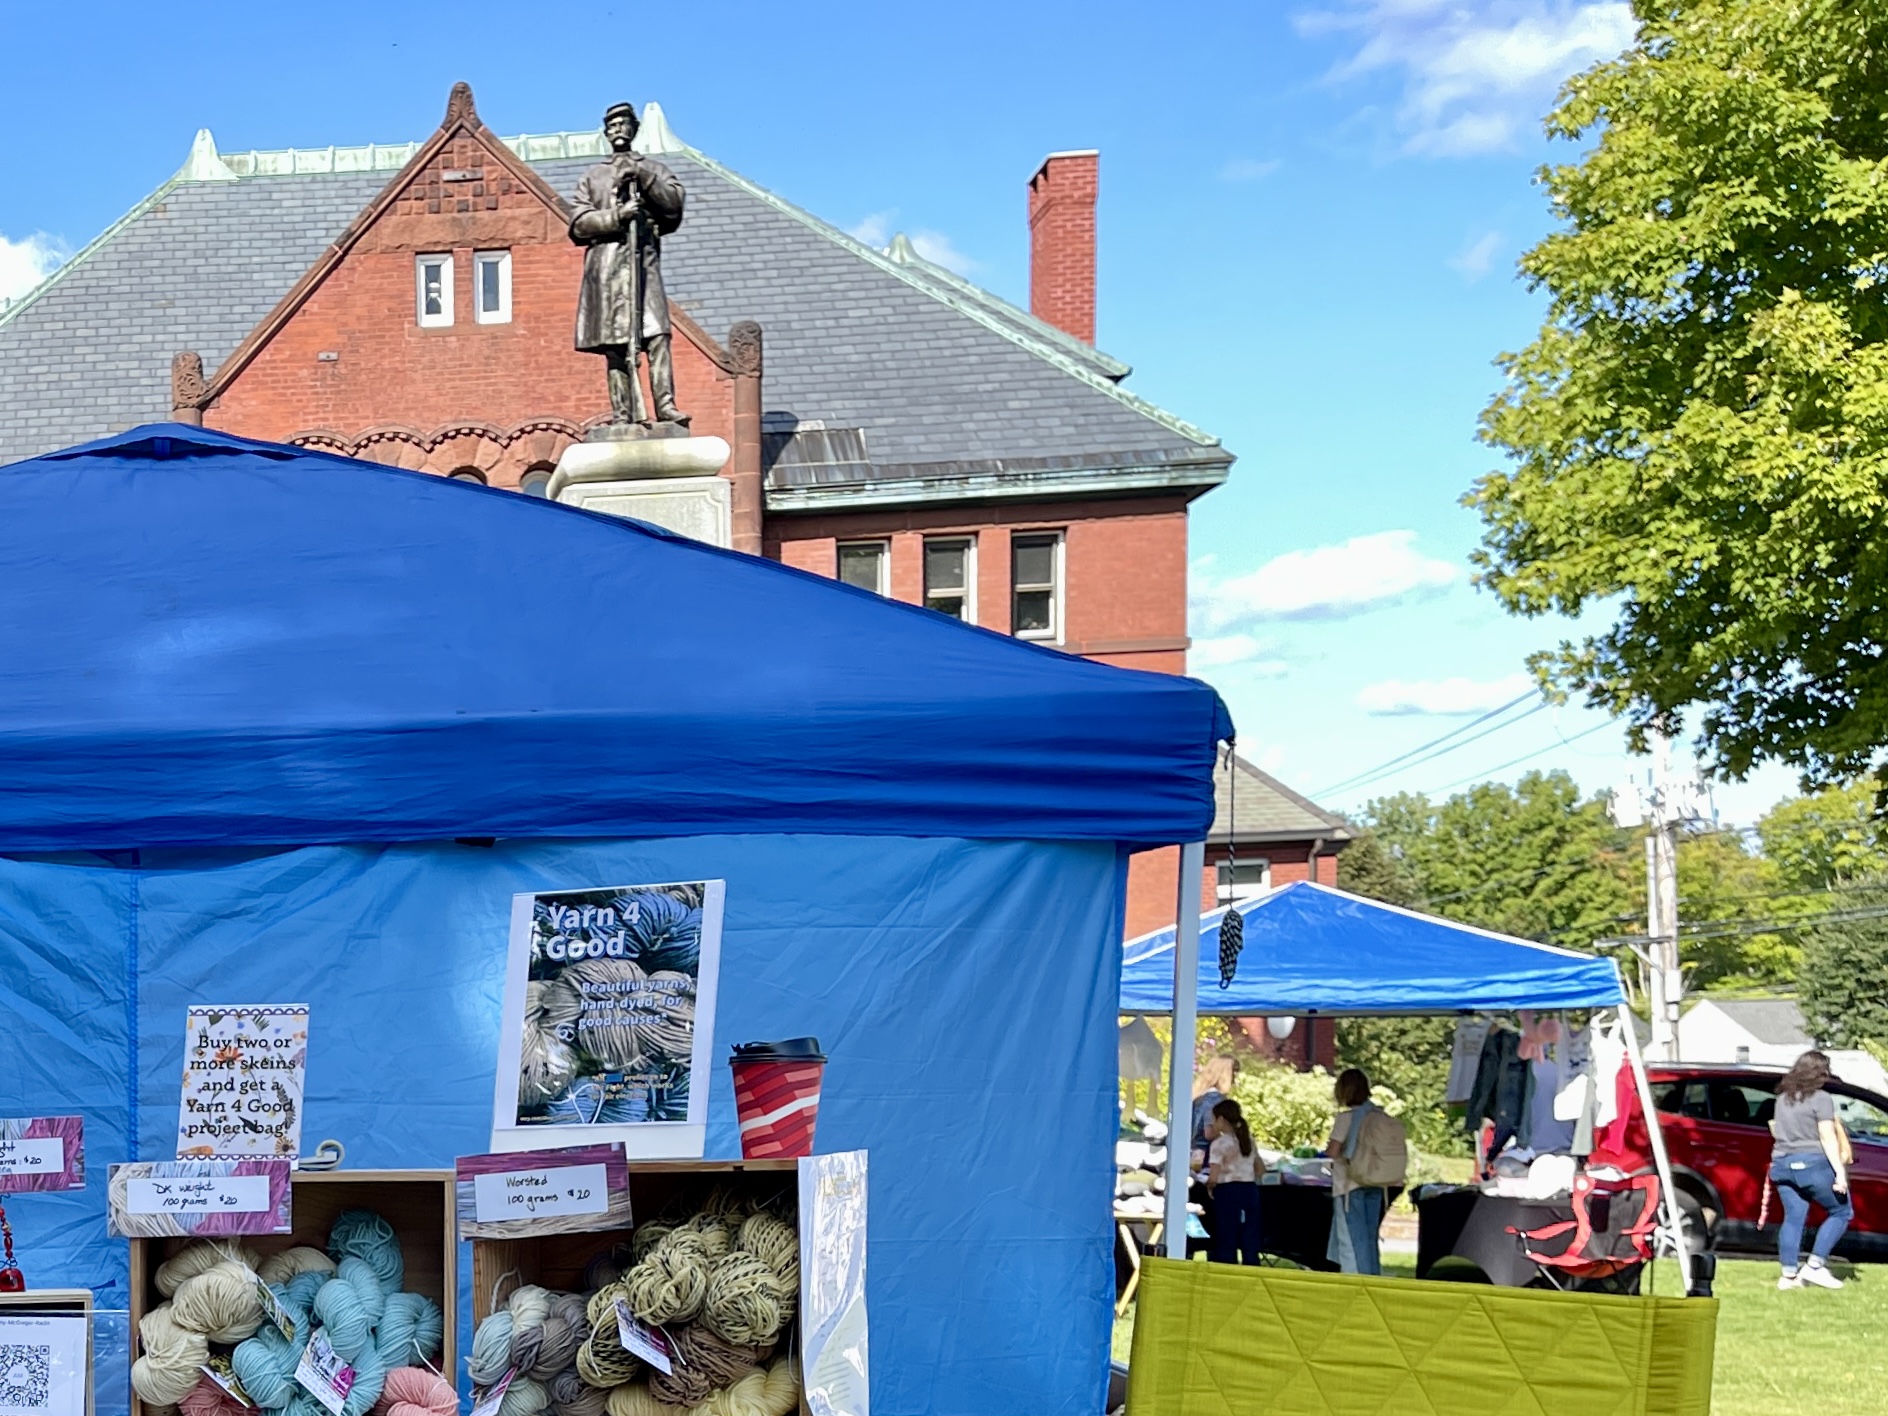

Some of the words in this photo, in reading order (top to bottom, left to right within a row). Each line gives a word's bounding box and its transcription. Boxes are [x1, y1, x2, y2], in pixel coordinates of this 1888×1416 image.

[547, 904, 615, 931] Yarn
[622, 901, 642, 925] 4
[545, 930, 627, 961] Good
[581, 979, 646, 994] Beautiful
[646, 978, 693, 995] yarns,
[661, 993, 683, 1006] for
[577, 1016, 613, 1030] good
[198, 1035, 232, 1052] Buy
[237, 1038, 269, 1048] two
[273, 1039, 292, 1048] or
[189, 1058, 235, 1070] more
[240, 1055, 296, 1070] skeins
[201, 1076, 235, 1091] and
[239, 1078, 266, 1095] get
[270, 1081, 280, 1091] a
[186, 1099, 226, 1112] Yarn
[231, 1099, 242, 1112] 4
[247, 1097, 294, 1112] Good
[188, 1121, 250, 1138] project
[254, 1119, 288, 1138] bag!
[23, 1155, 43, 1165] $20
[178, 1180, 216, 1198] weight
[505, 1174, 549, 1188] Worsted
[162, 1197, 180, 1207] 100
[181, 1197, 209, 1210] grams
[219, 1194, 239, 1205] $20
[507, 1195, 525, 1205] 100
[527, 1194, 560, 1213] grams
